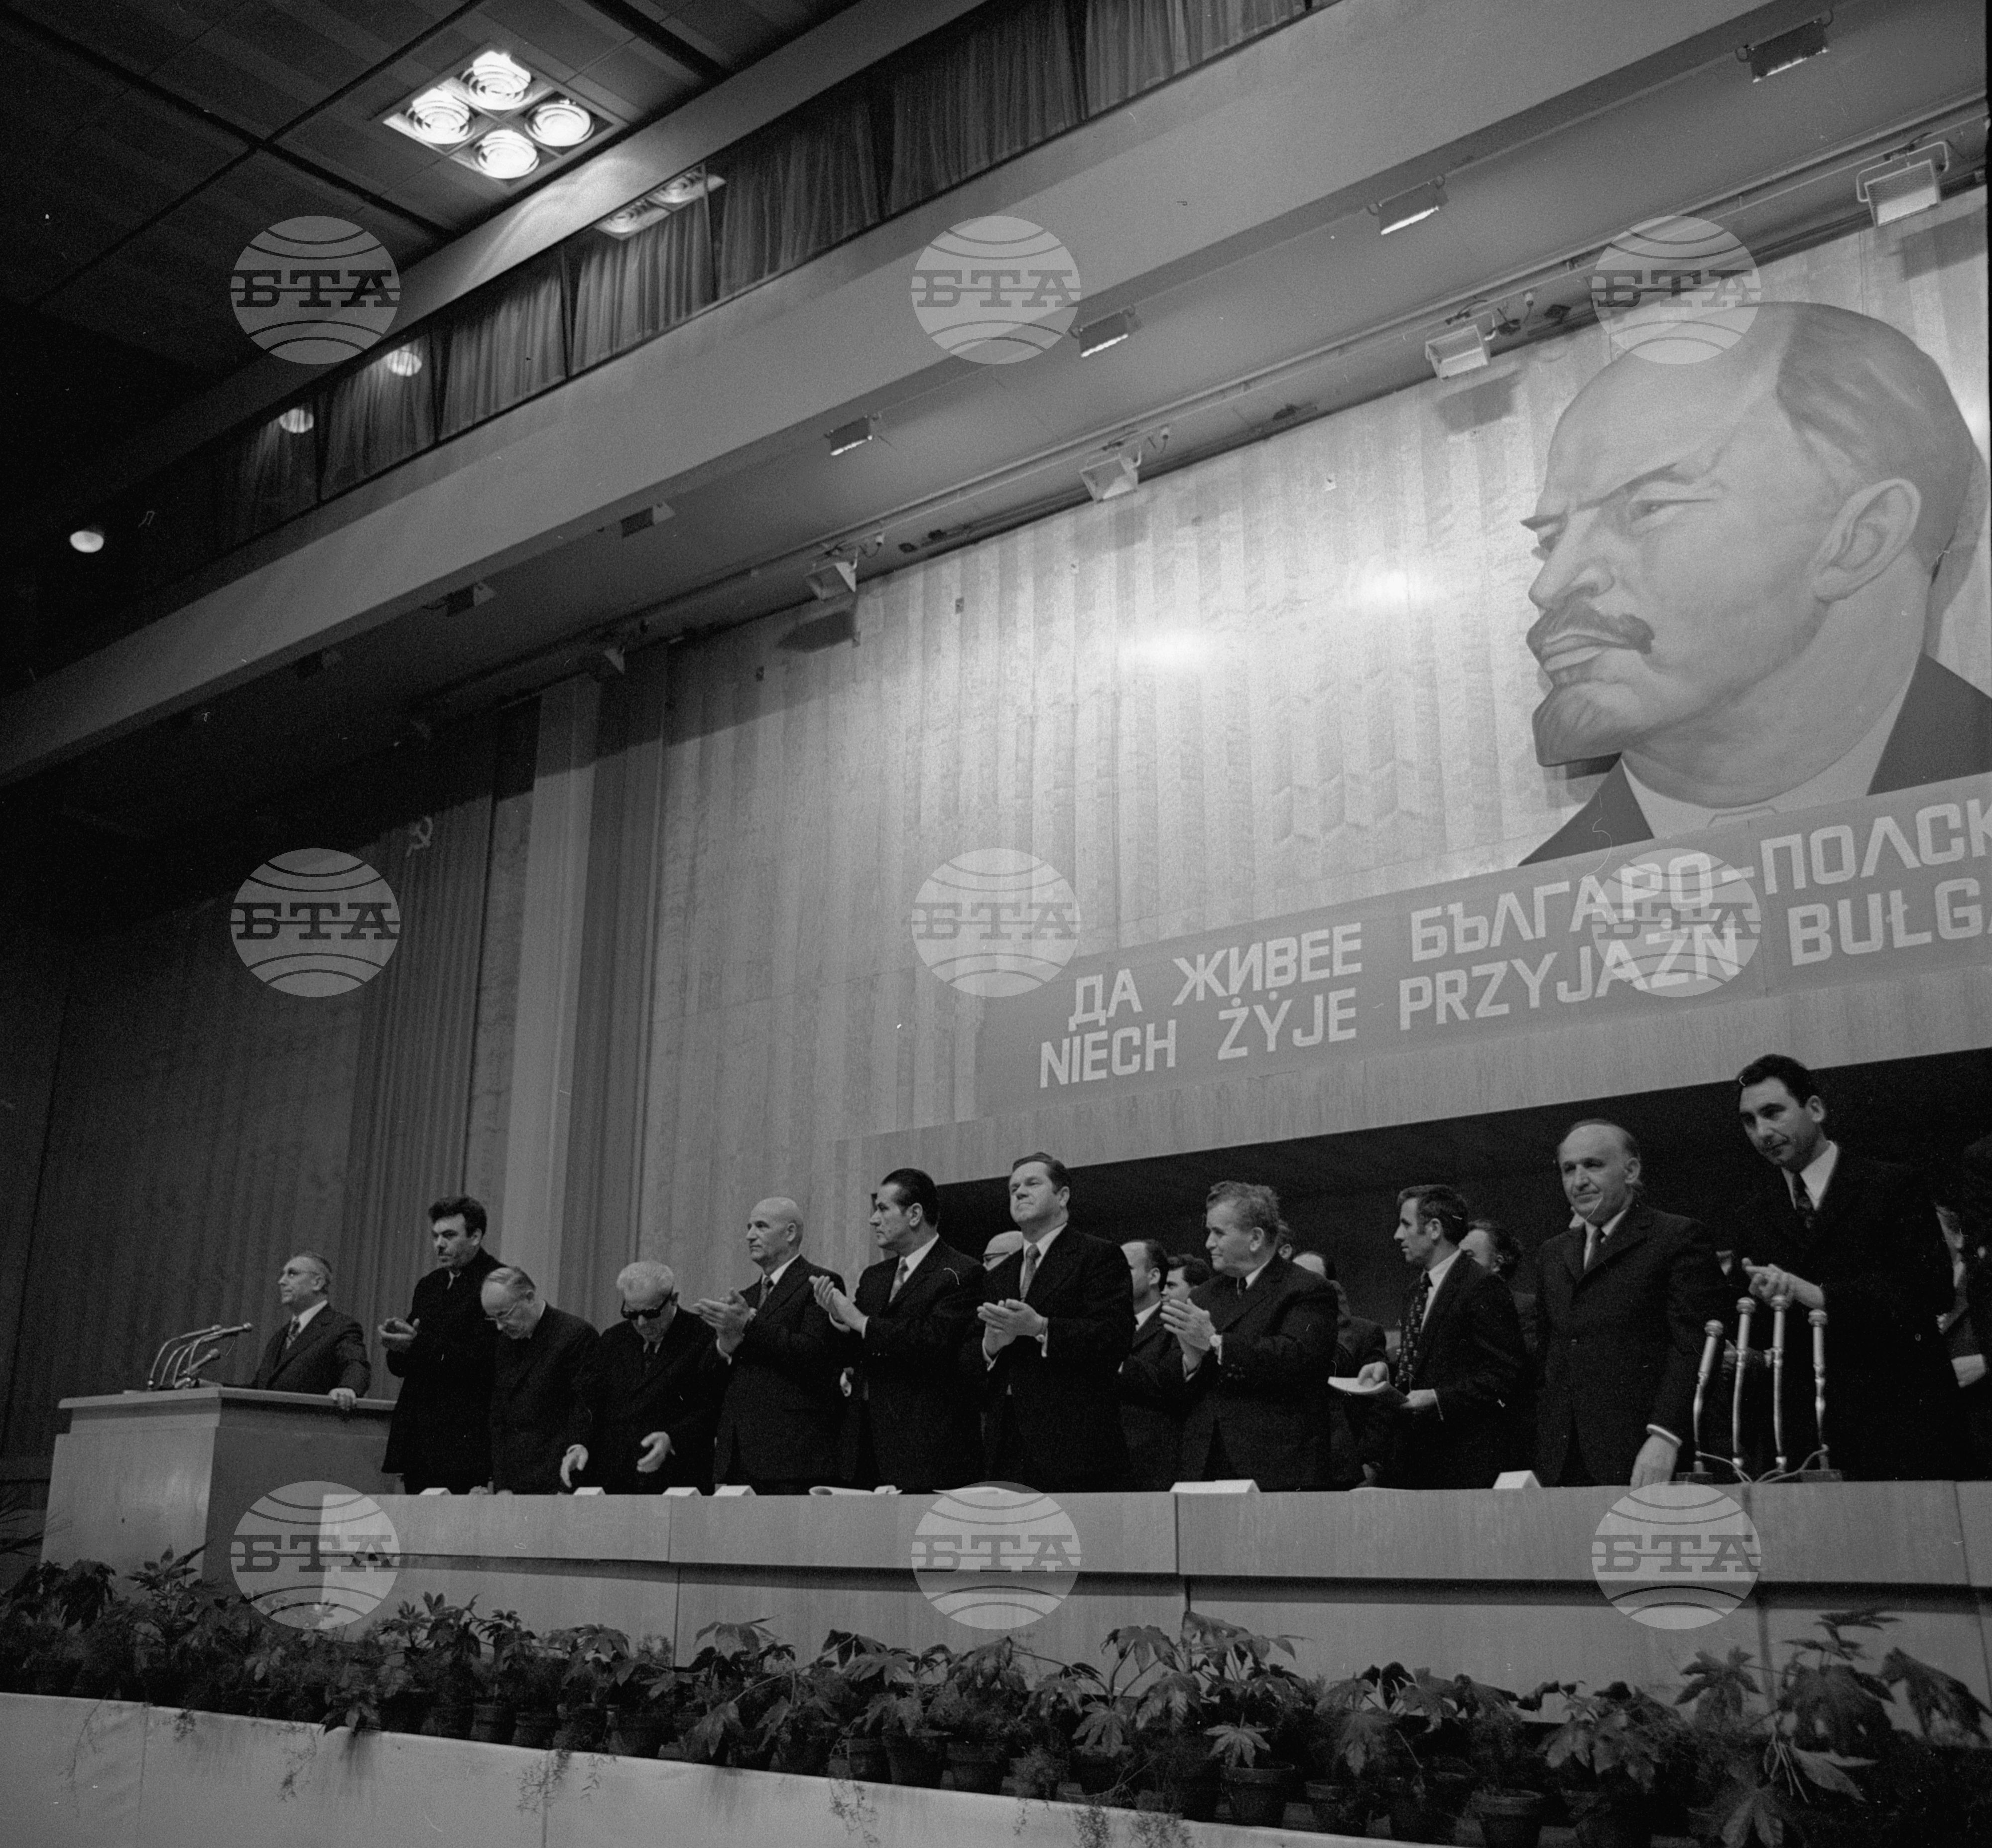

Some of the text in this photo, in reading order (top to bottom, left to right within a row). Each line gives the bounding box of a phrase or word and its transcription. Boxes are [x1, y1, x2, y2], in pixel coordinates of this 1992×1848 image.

[1040, 1019, 1177, 1088] NIECH
[1787, 877, 1992, 966] BUŁG
[1068, 968, 1142, 1032] ДА
[1171, 922, 1362, 1006] ЖИВЕЕ
